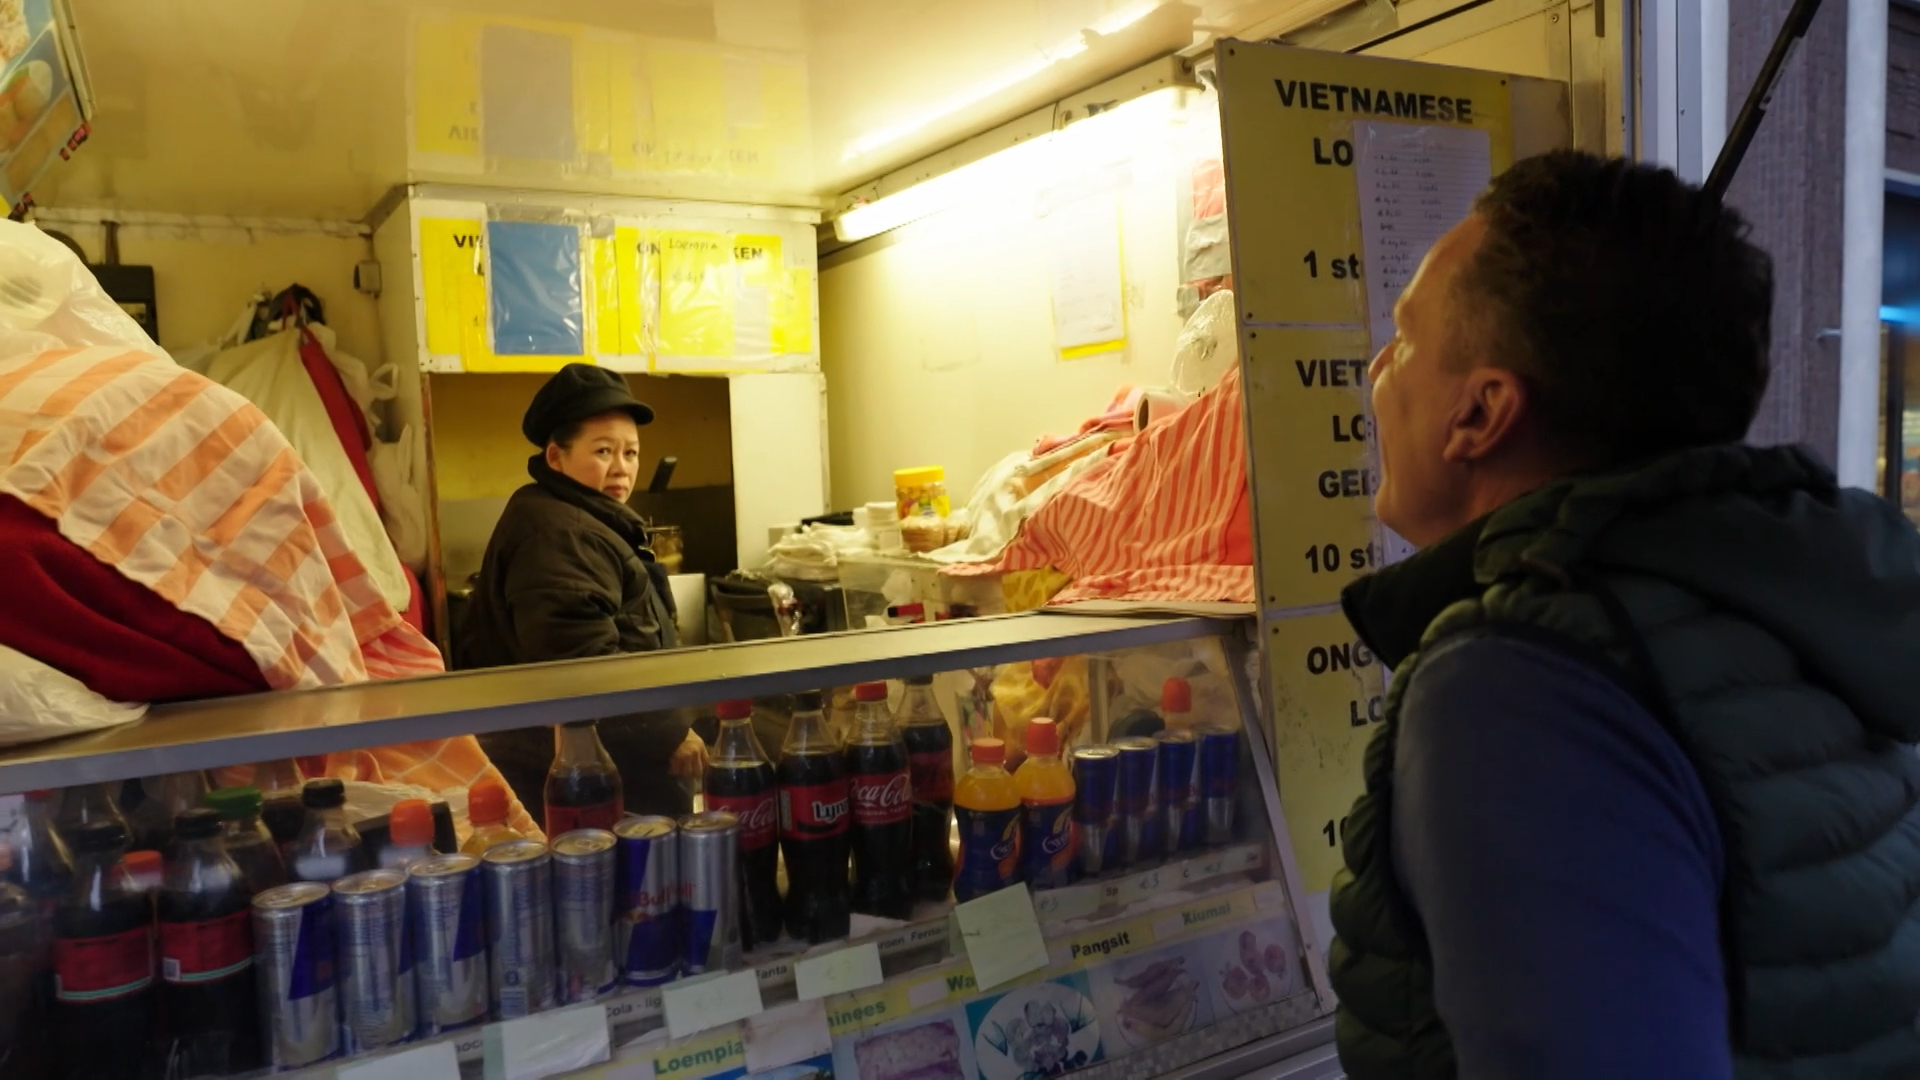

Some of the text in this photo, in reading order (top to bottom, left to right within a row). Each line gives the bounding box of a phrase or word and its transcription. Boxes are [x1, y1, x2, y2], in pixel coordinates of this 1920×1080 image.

[1275, 79, 1473, 124] VIETNAMESE
[1303, 251, 1319, 279] 1
[1305, 544, 1340, 573] 10
[1071, 931, 1130, 958] Pangsit
[653, 1040, 743, 1075] Loempia
